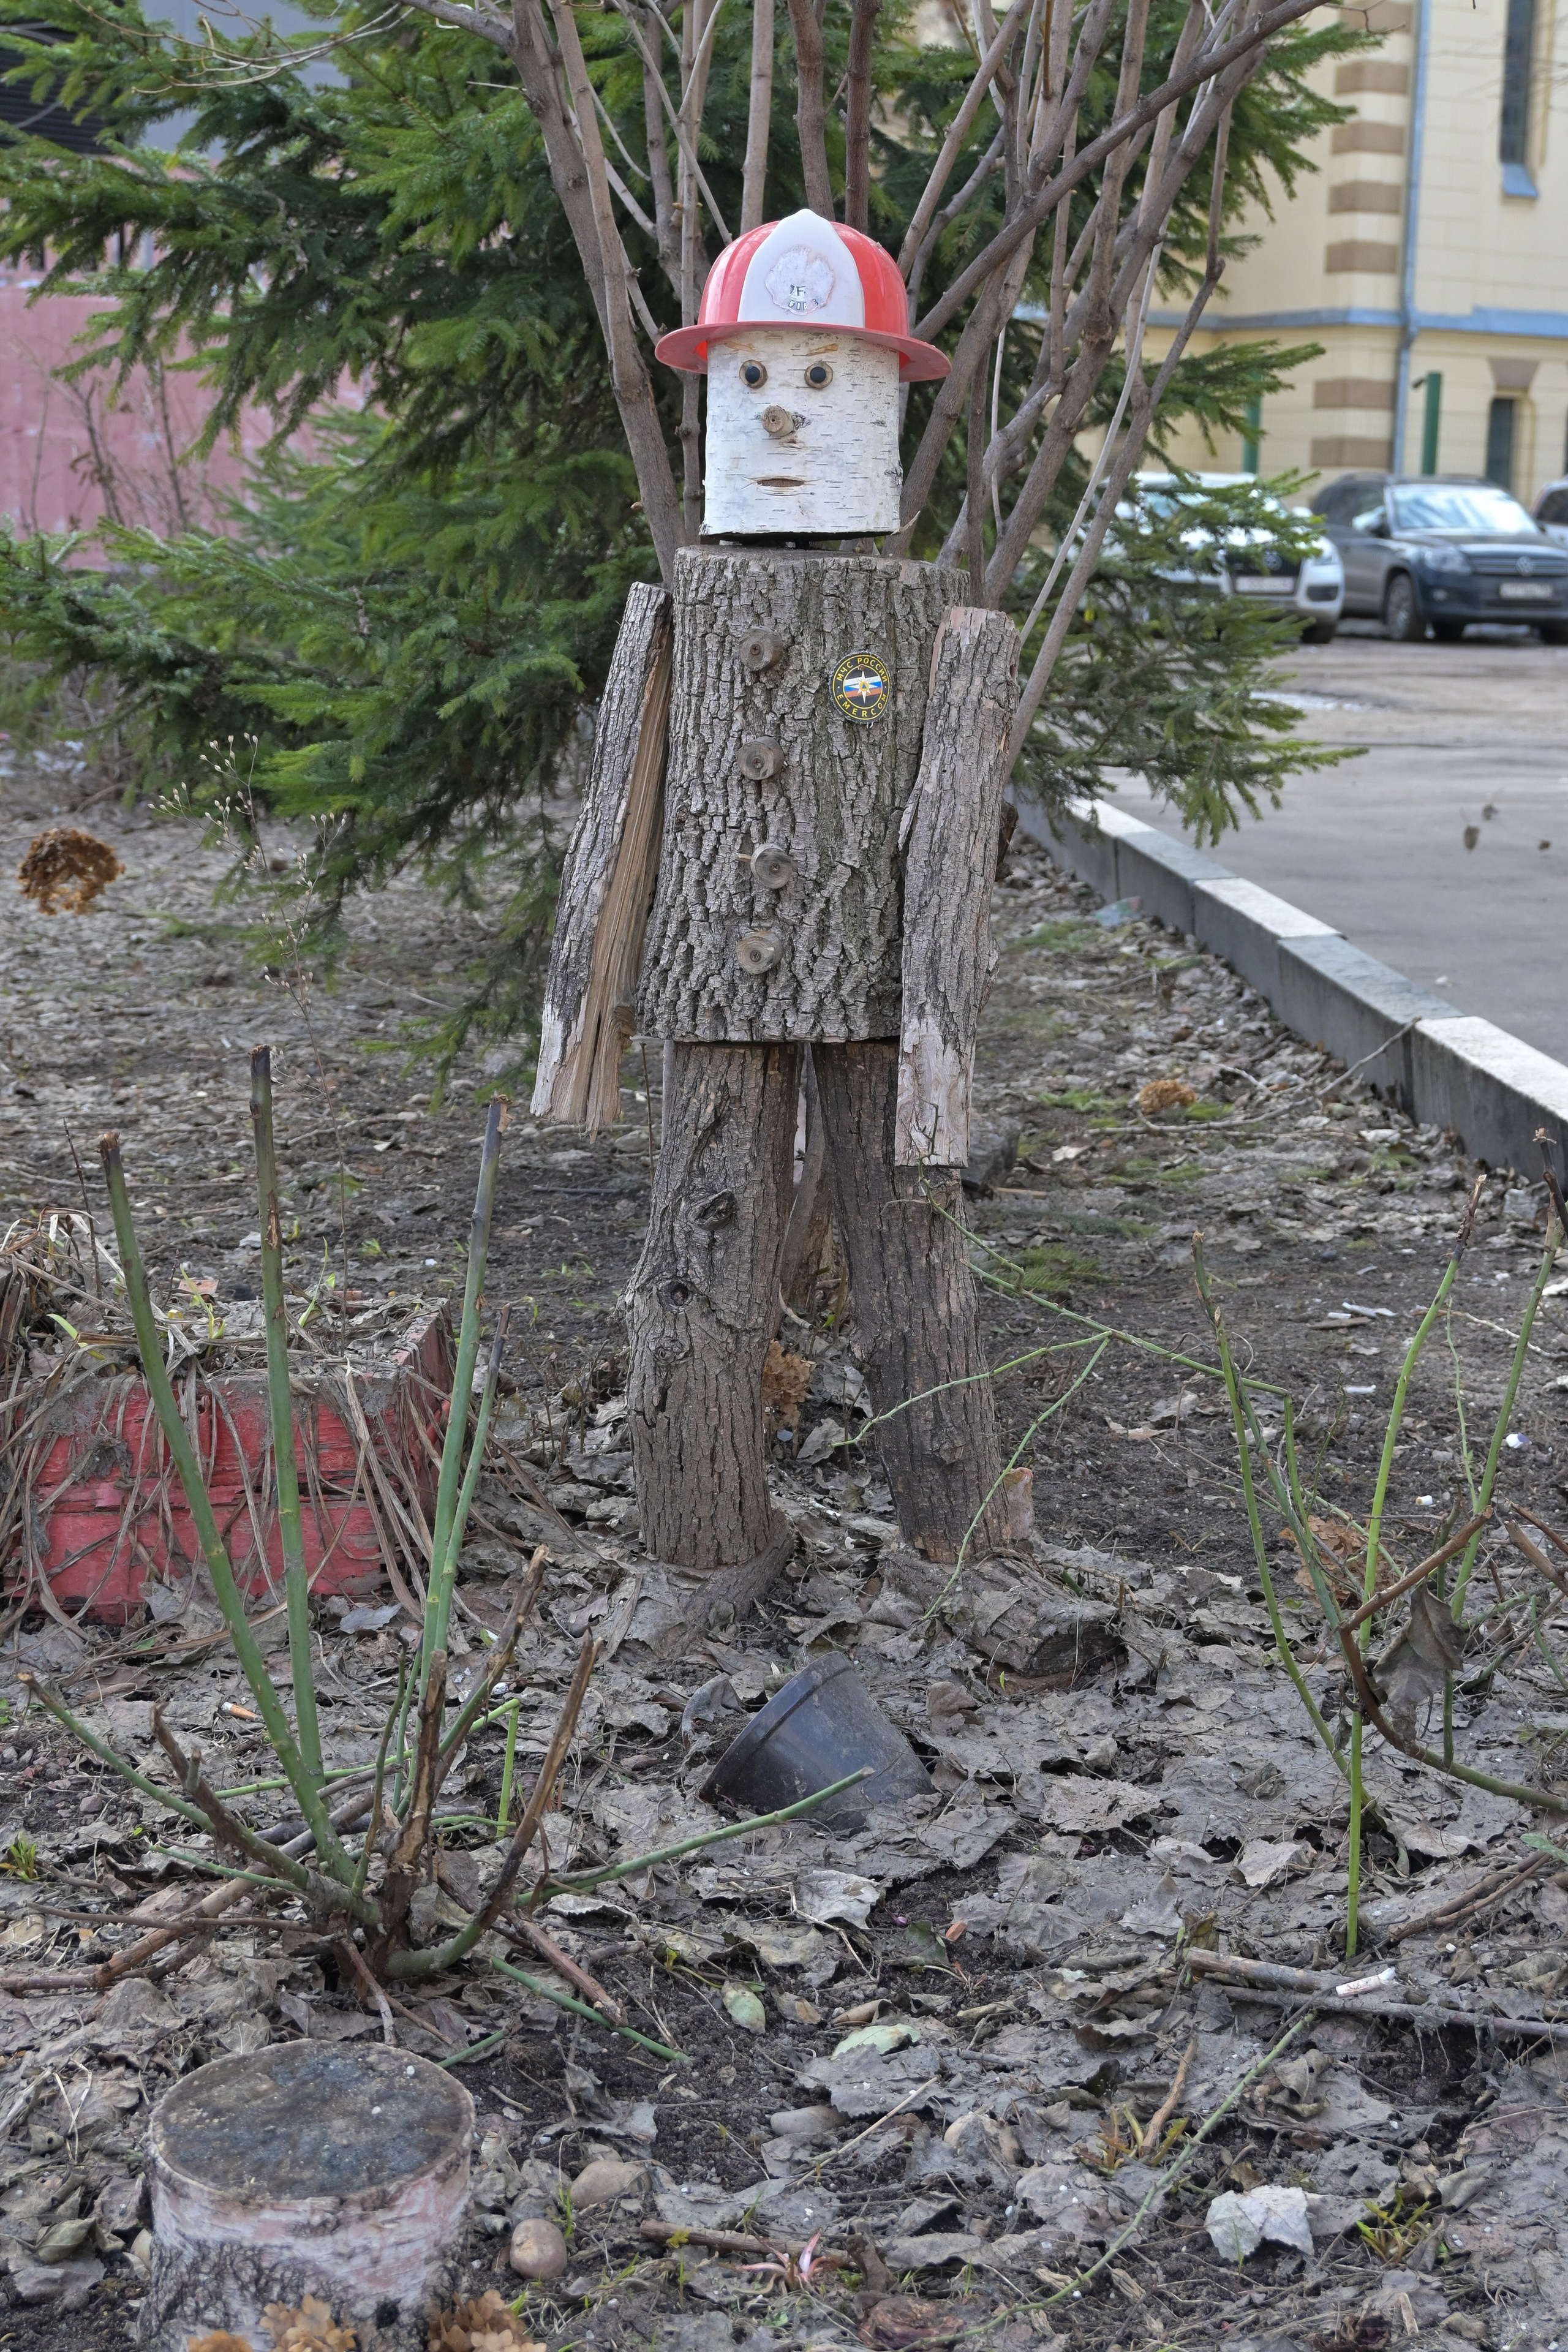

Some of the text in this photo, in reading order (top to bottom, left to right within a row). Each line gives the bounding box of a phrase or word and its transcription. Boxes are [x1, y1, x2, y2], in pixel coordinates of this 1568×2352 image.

[836, 657, 889, 682] МЧС РОССИИ
[837, 693, 888, 717] EMERCOM
